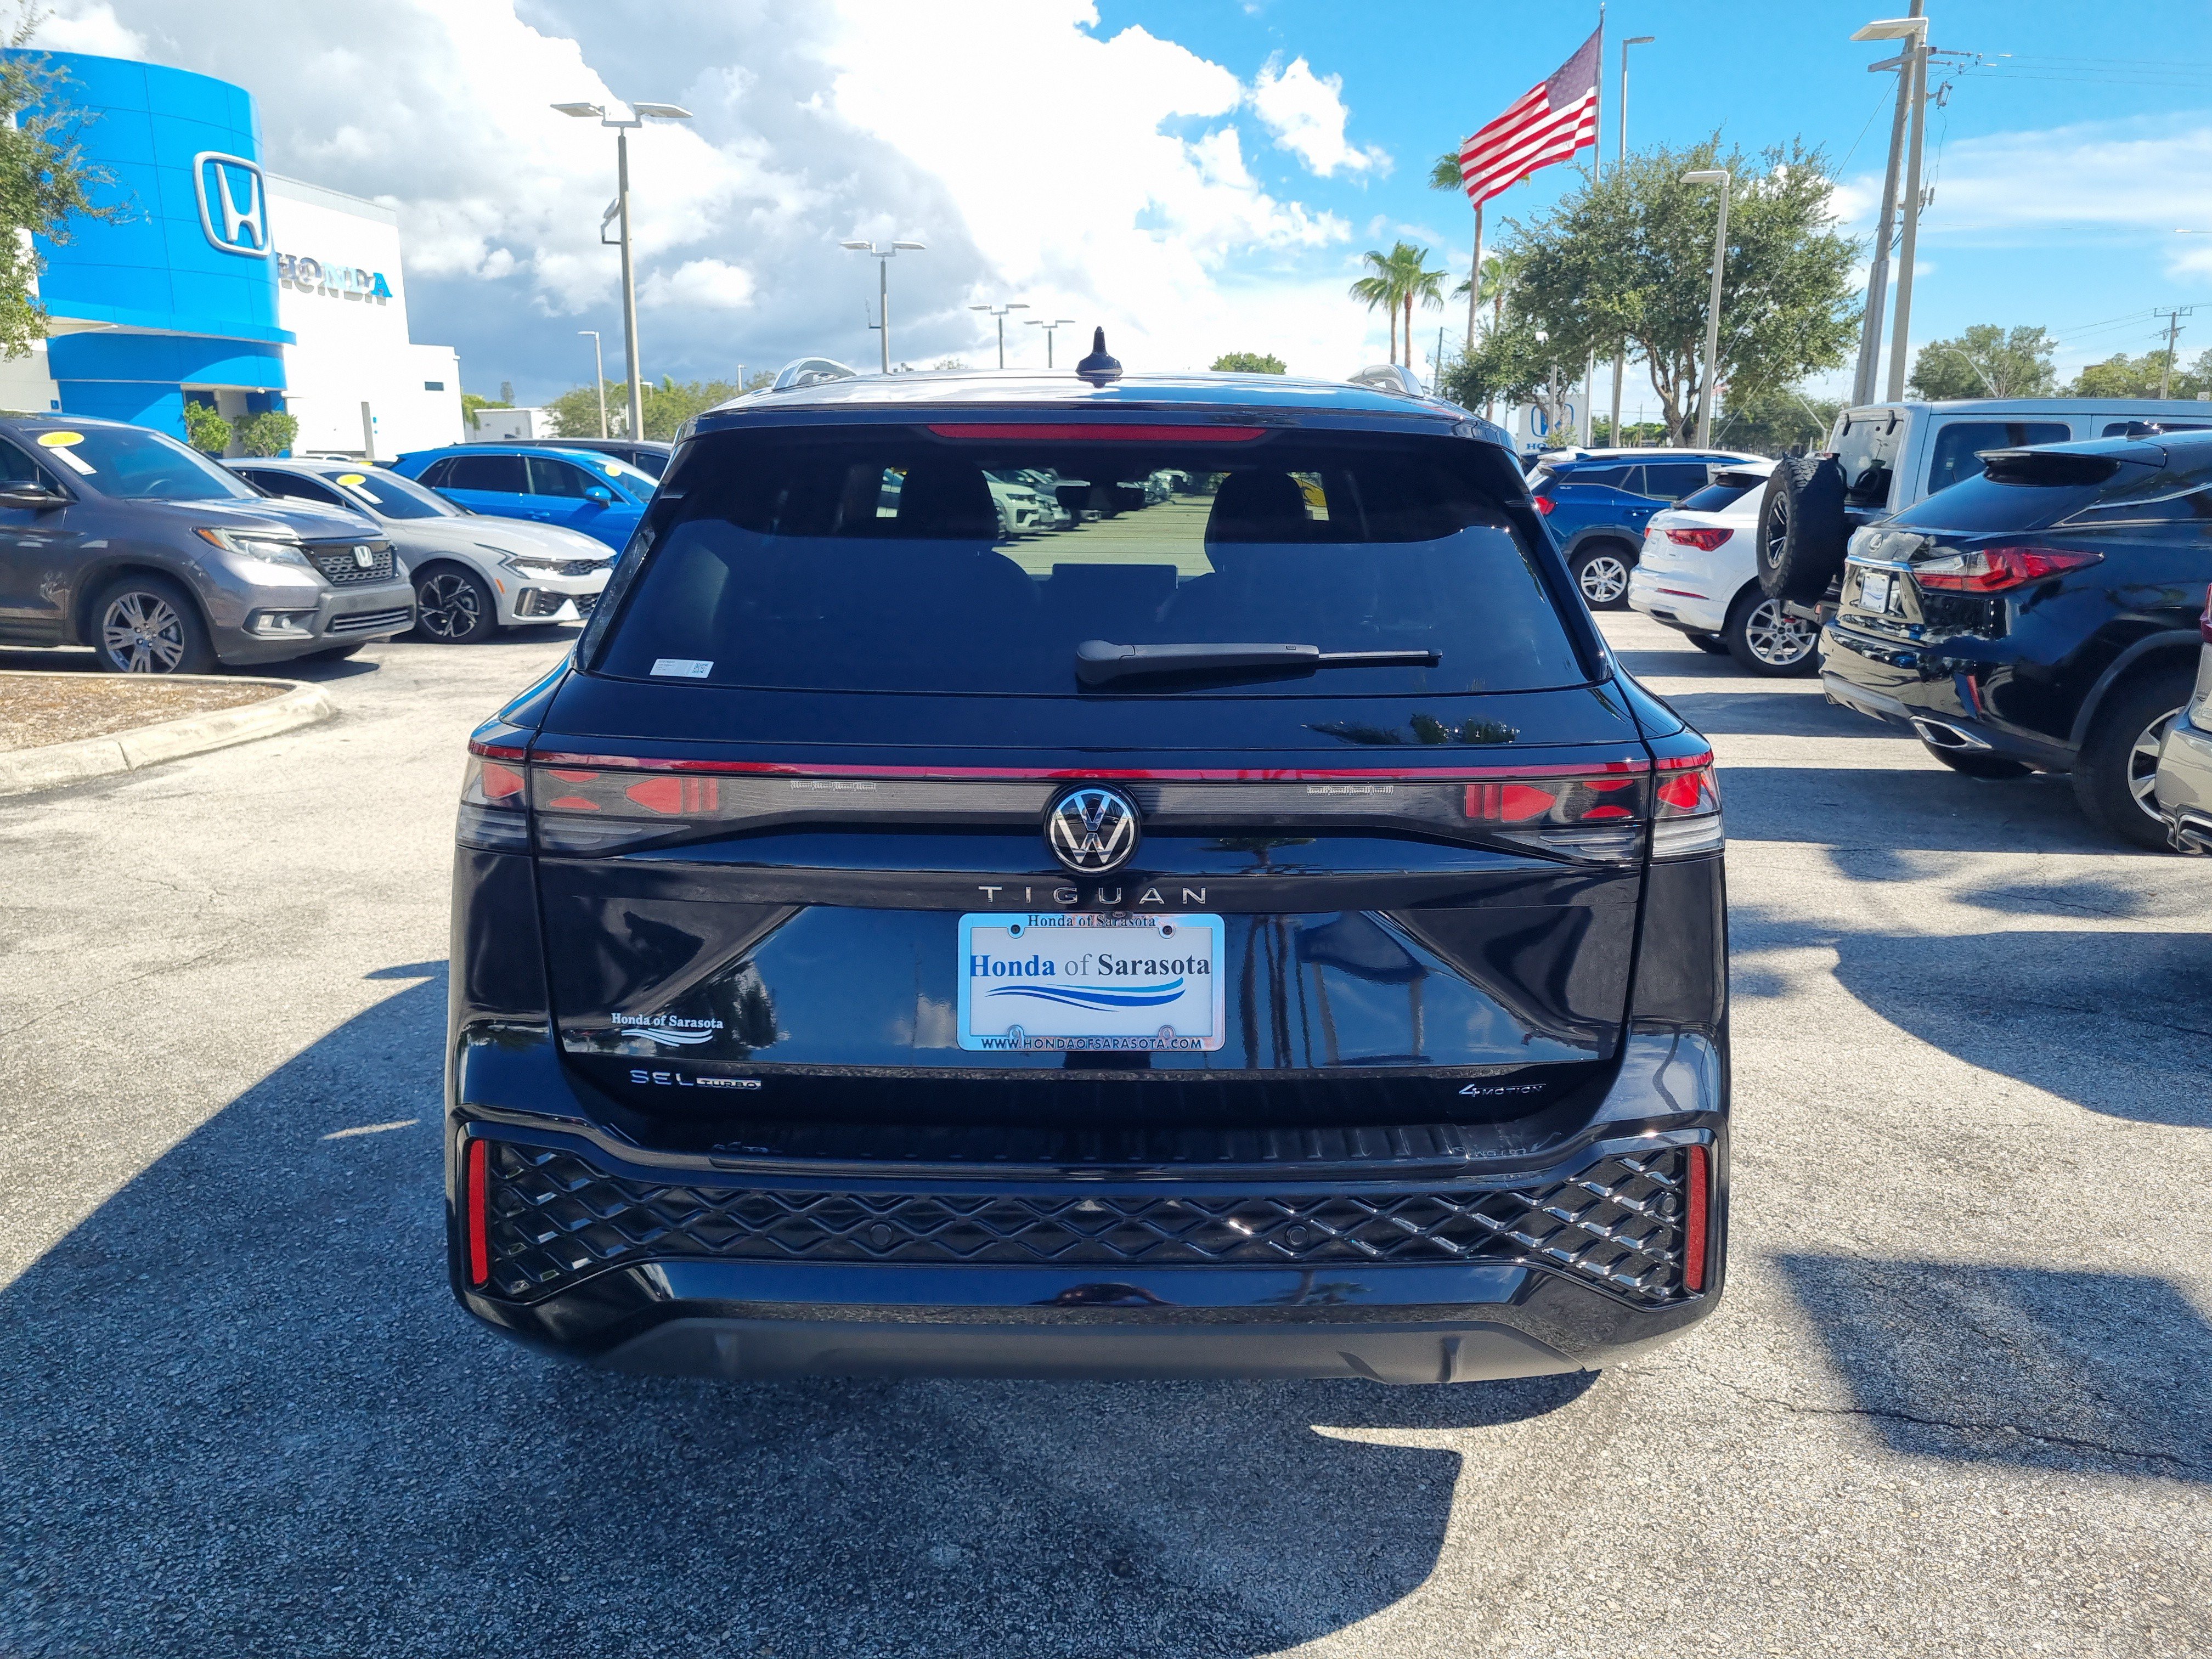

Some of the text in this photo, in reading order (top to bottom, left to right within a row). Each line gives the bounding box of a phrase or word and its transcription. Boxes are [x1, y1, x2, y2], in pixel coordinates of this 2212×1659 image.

[276, 252, 393, 298] HONDA
[978, 885, 1206, 905] TIGUAN
[1028, 915, 1156, 927] Honda of Sarasota
[970, 953, 1211, 977] Honda of Sarasota
[611, 1013, 724, 1029] Honda of Sarasota
[981, 1039, 1201, 1049] WWW.HONDAOFSARASOTA.COM
[630, 1070, 758, 1089] SEL TURBO
[1458, 1084, 1543, 1097] 4MOTION
